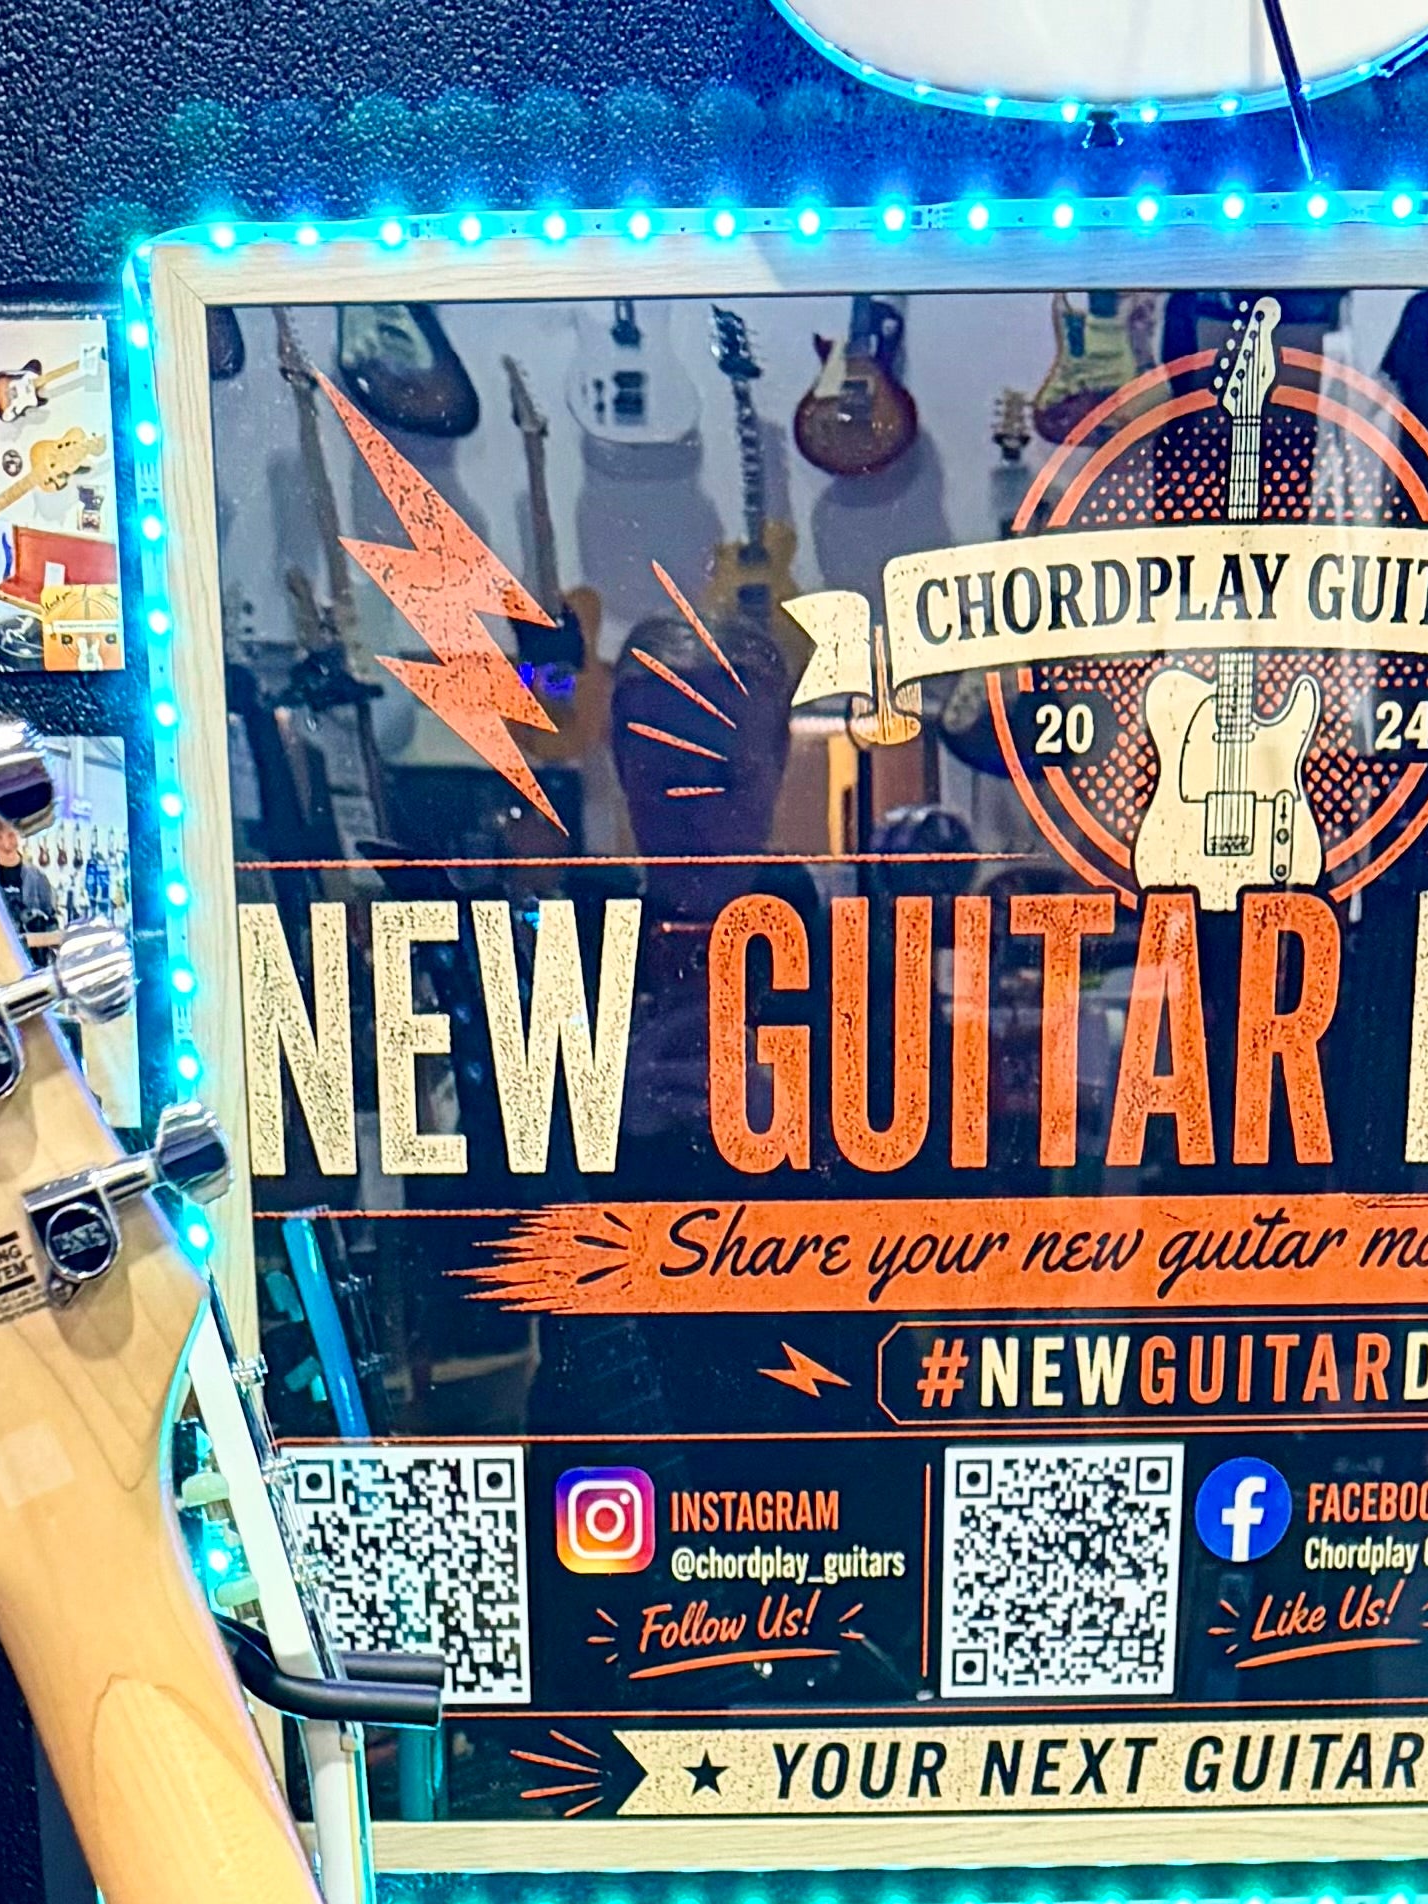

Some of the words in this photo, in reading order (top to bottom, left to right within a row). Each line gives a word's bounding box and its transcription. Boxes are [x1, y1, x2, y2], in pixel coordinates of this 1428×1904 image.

[915, 551, 1290, 645] CHORDPLAY
[1033, 705, 1094, 755] 20
[238, 898, 643, 1176] NEW
[709, 889, 1341, 1175] GUITAR
[659, 1208, 851, 1280] Share
[866, 1225, 1006, 1305] your
[1018, 1223, 1143, 1275] new
[1157, 1212, 1348, 1299] guitar
[670, 1488, 840, 1533] INSTAGRAM
[670, 1543, 905, 1585] @chordplay_guitars
[1303, 1535, 1418, 1575] Chordplay
[638, 1597, 748, 1654] Follow
[756, 1589, 815, 1641] Us!
[1251, 1591, 1329, 1641] Like
[1338, 1579, 1401, 1634] Us!
[773, 1741, 944, 1800] YOUR
[977, 1737, 1158, 1797] NEXT
[1183, 1731, 1424, 1796] GUITAR
